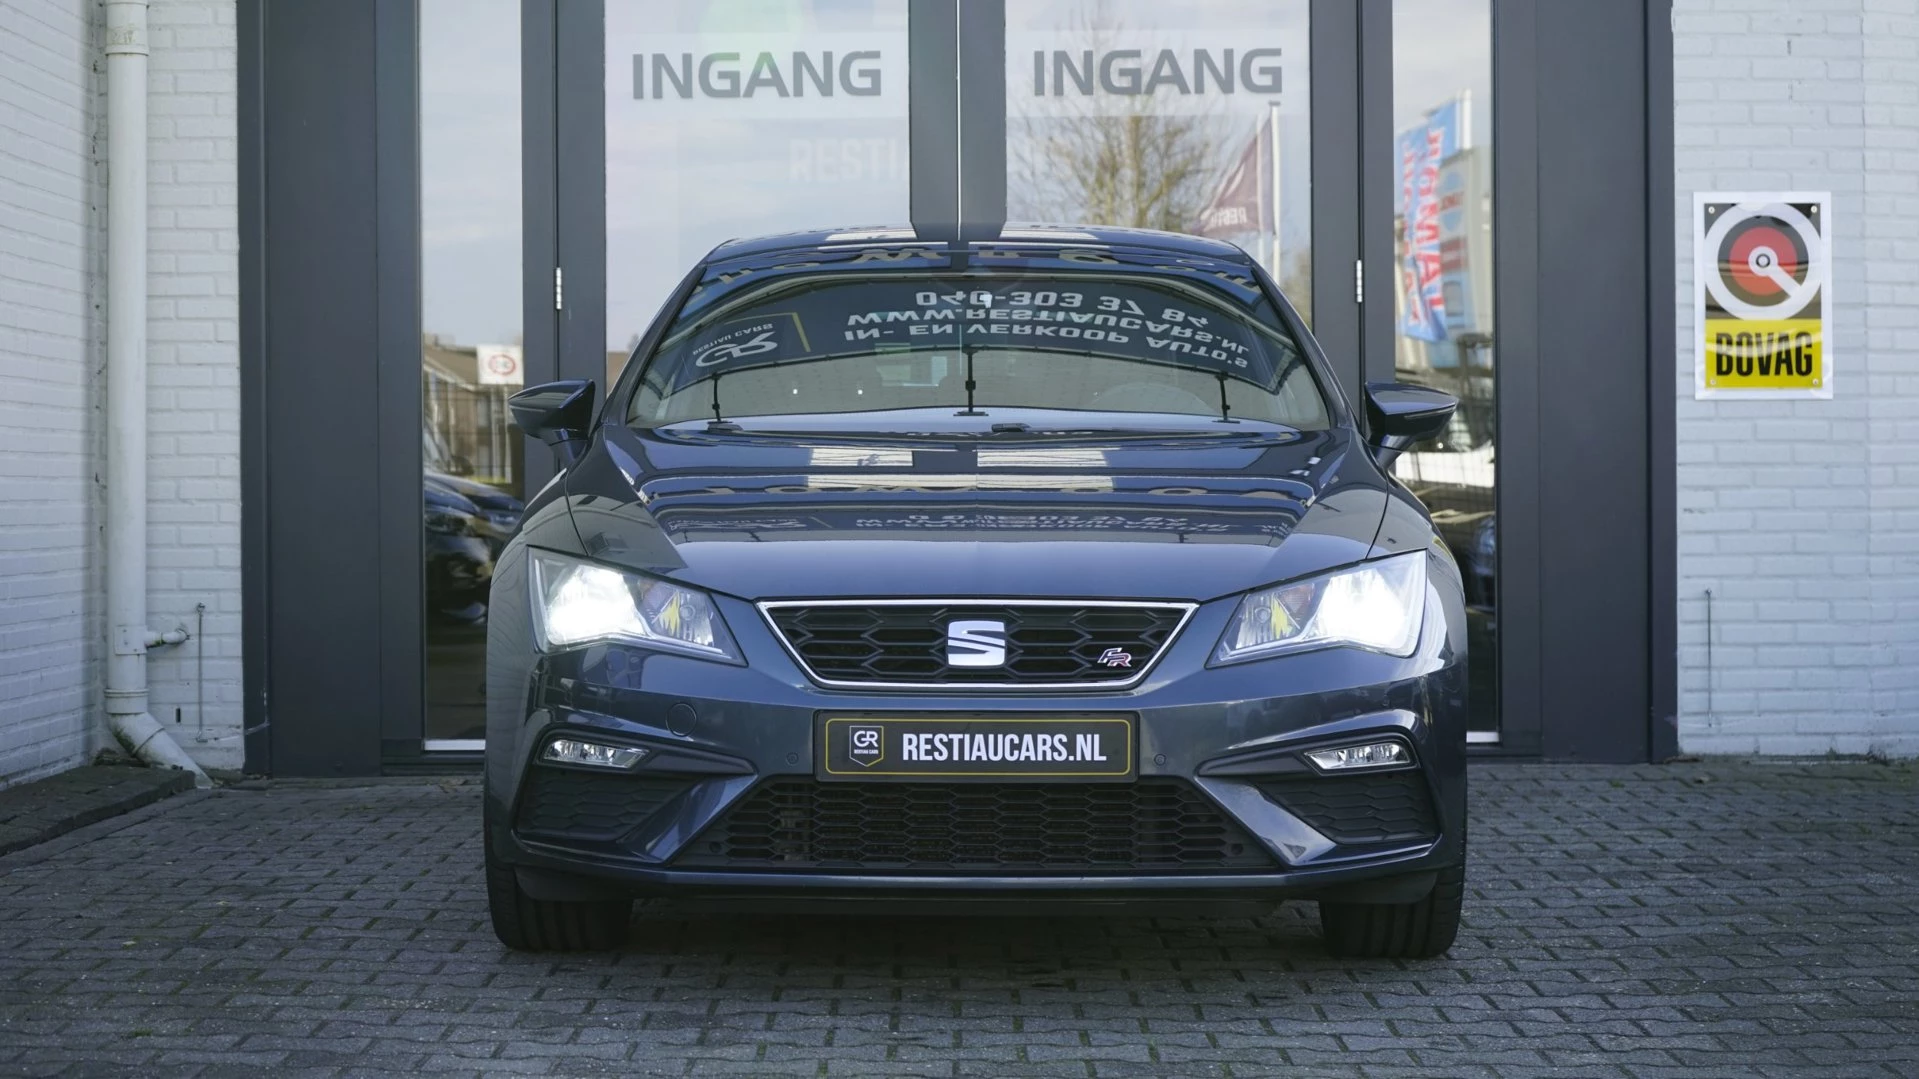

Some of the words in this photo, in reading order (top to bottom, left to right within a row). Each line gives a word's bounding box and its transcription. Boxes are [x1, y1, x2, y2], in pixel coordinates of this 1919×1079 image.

[632, 50, 882, 100] INGANG
[1033, 47, 1284, 97] INGANG
[1716, 332, 1812, 377] BOVAG
[902, 733, 1107, 762] RESTIAUCARS.NL
